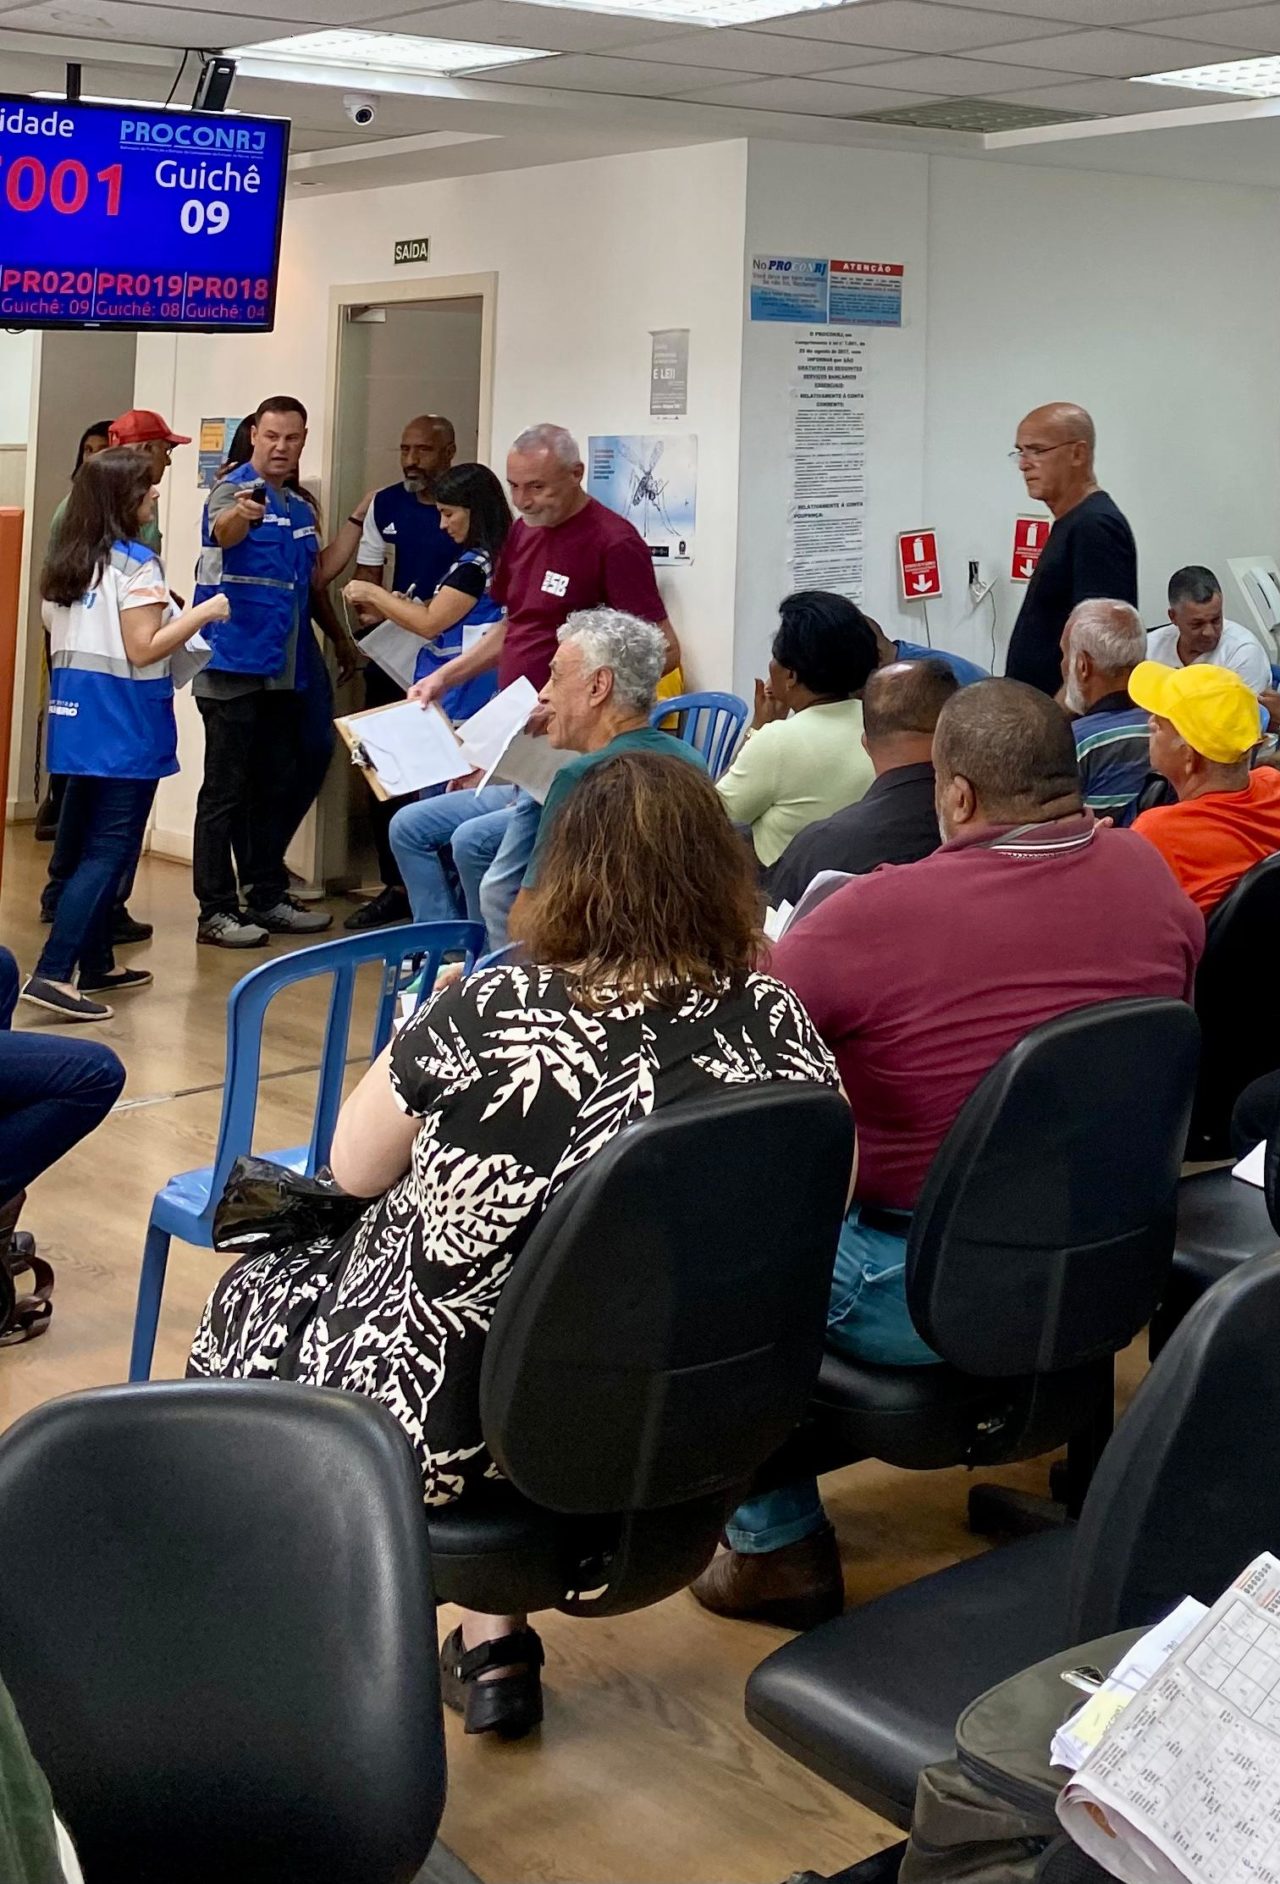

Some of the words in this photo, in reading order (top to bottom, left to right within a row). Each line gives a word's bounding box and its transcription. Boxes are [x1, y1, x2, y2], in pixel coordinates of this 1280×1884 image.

[0, 108, 75, 137] idade
[120, 120, 266, 151] PROCONRJ
[0, 155, 123, 216] 001
[155, 160, 261, 193] Guichê
[180, 199, 230, 235] 09
[752, 259, 767, 270] No
[768, 260, 826, 276] PROCONRJ
[843, 263, 892, 274] ATENÇÃO
[2, 269, 93, 294] PR020
[98, 273, 183, 297] PR019
[187, 277, 269, 300] PR018
[2, 298, 64, 315] Guichê:
[69, 300, 90, 315] 09
[96, 301, 155, 316] Guichê:
[160, 302, 180, 317] 08
[186, 302, 242, 319] Guichê:
[247, 305, 266, 319] 04
